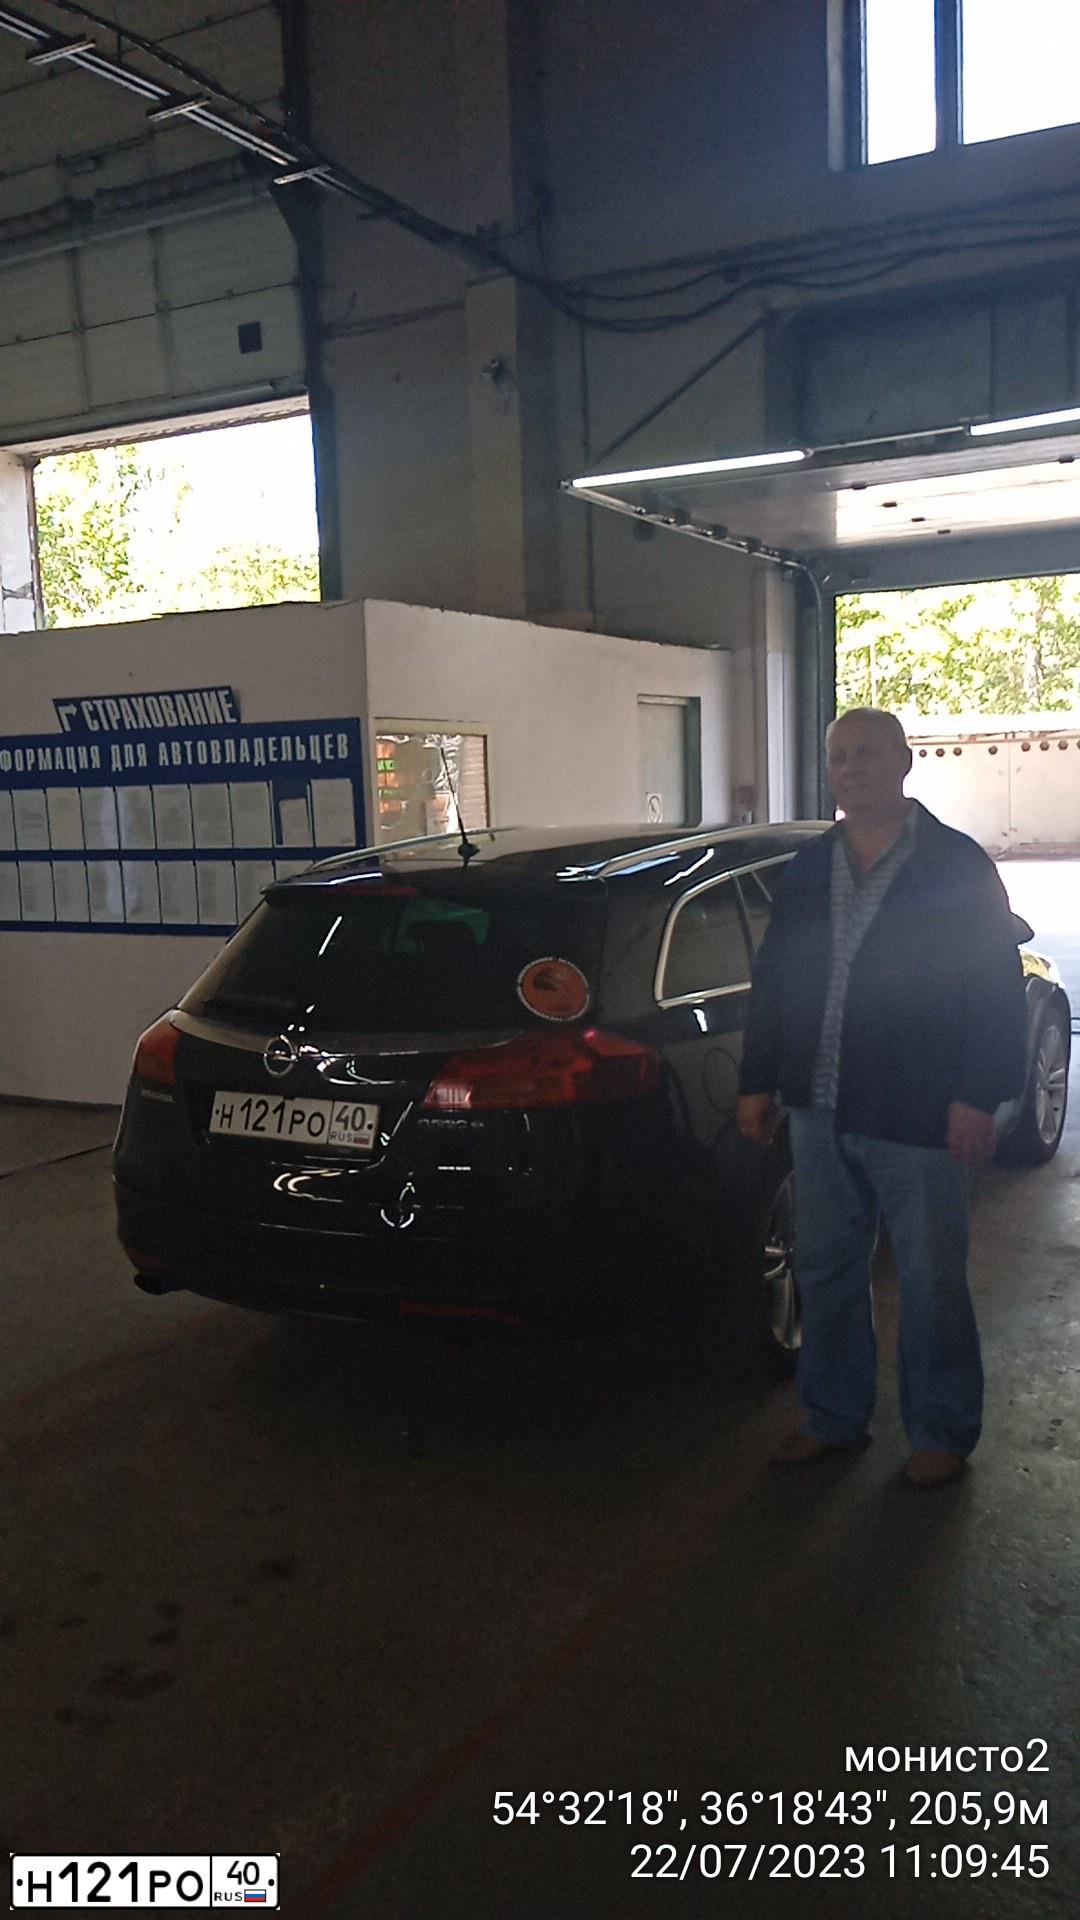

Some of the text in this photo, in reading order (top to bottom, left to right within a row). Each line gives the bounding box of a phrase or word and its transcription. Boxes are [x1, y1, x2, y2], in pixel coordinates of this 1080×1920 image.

[80, 689, 237, 731] СТРАХОВАНИЕ
[110, 741, 148, 772] ДЛЯ
[158, 733, 348, 767] АВТОВЛАДЕЛЬЦЕВ
[335, 1104, 366, 1131] 40
[330, 1132, 352, 1143] RUS
